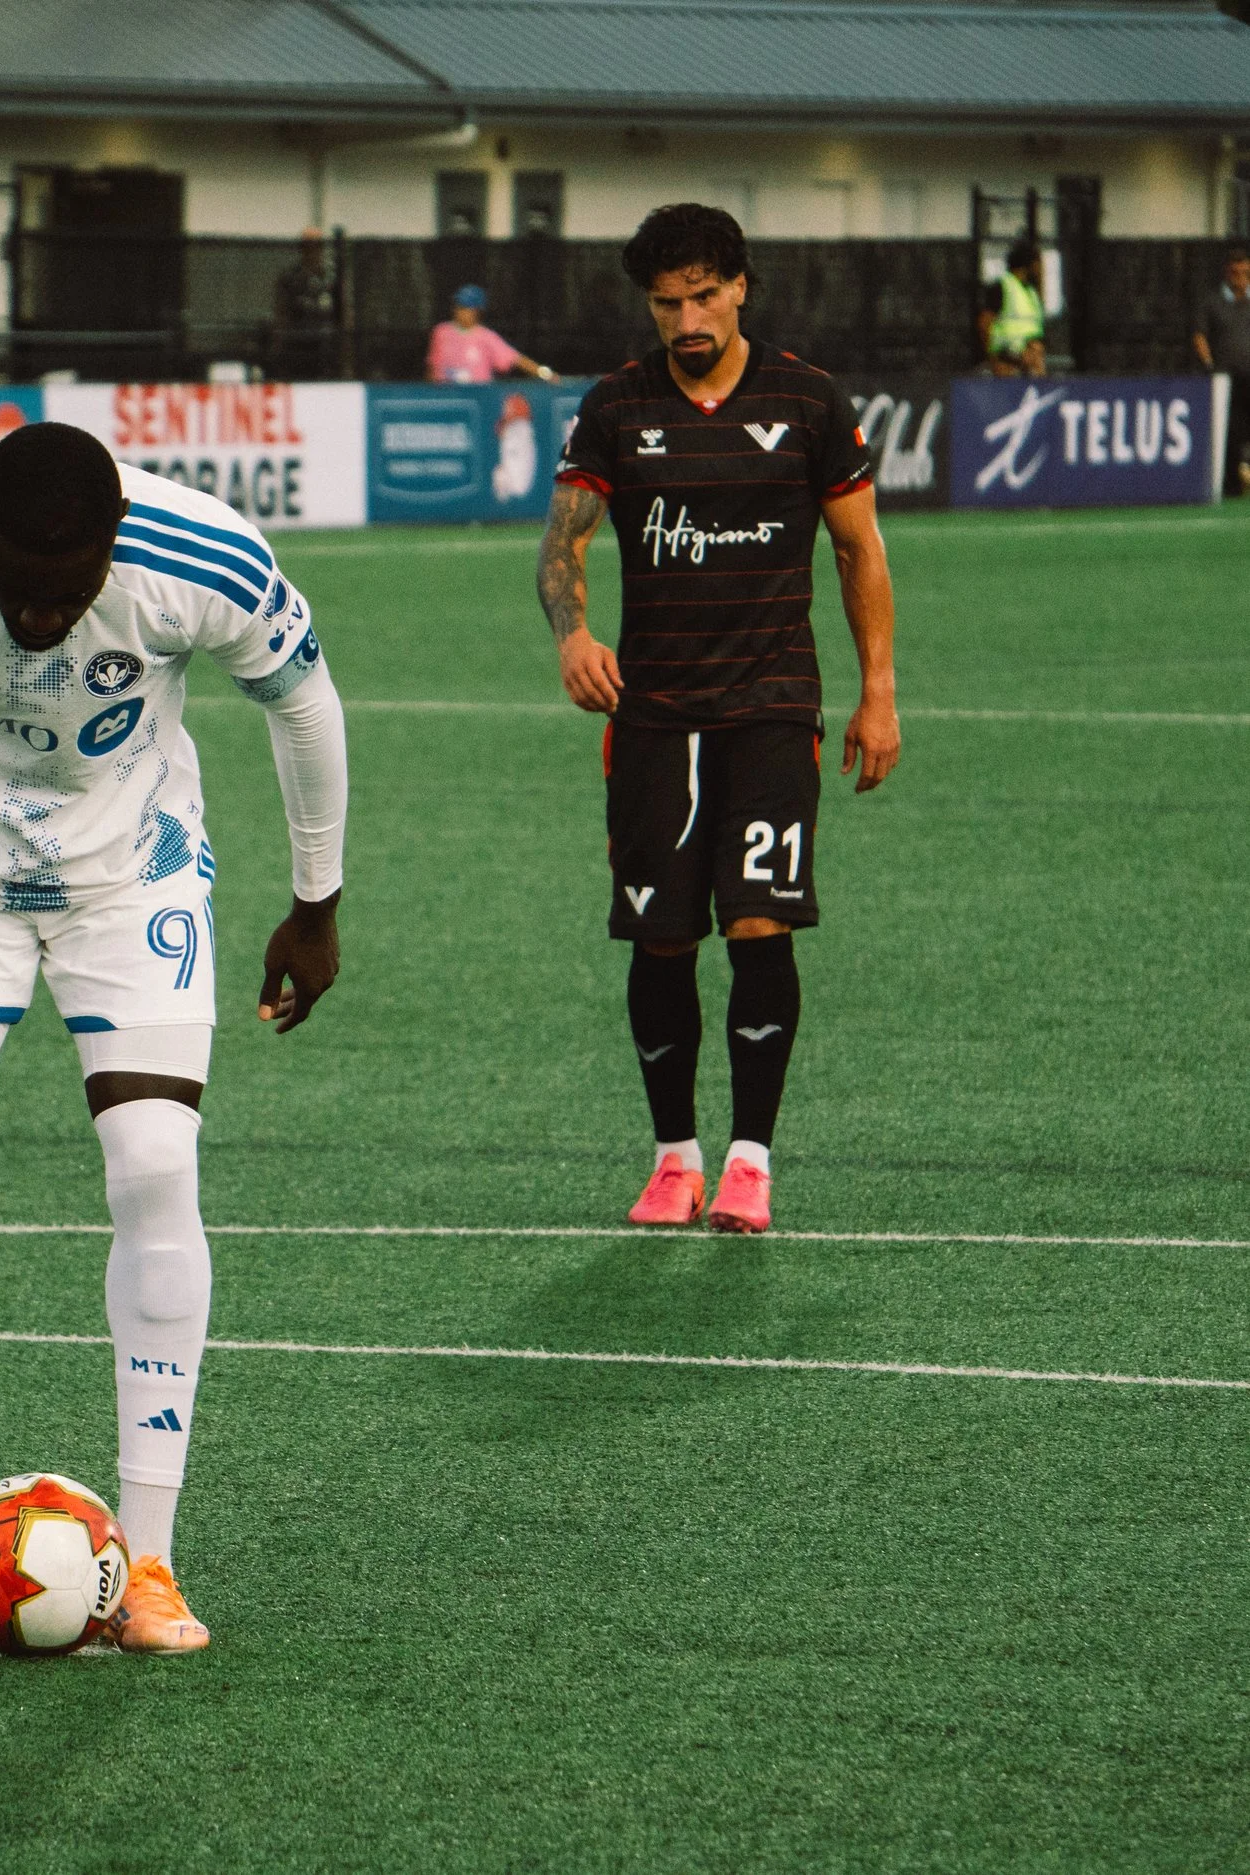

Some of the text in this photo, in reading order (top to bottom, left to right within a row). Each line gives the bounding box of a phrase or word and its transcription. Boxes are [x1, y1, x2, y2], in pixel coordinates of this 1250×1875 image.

[113, 383, 304, 444] SENTINEL
[1059, 398, 1192, 465] TELUS
[642, 496, 784, 568] Artigiano
[743, 821, 801, 882] 21
[147, 907, 197, 990] 9
[130, 1357, 185, 1377] MTL
